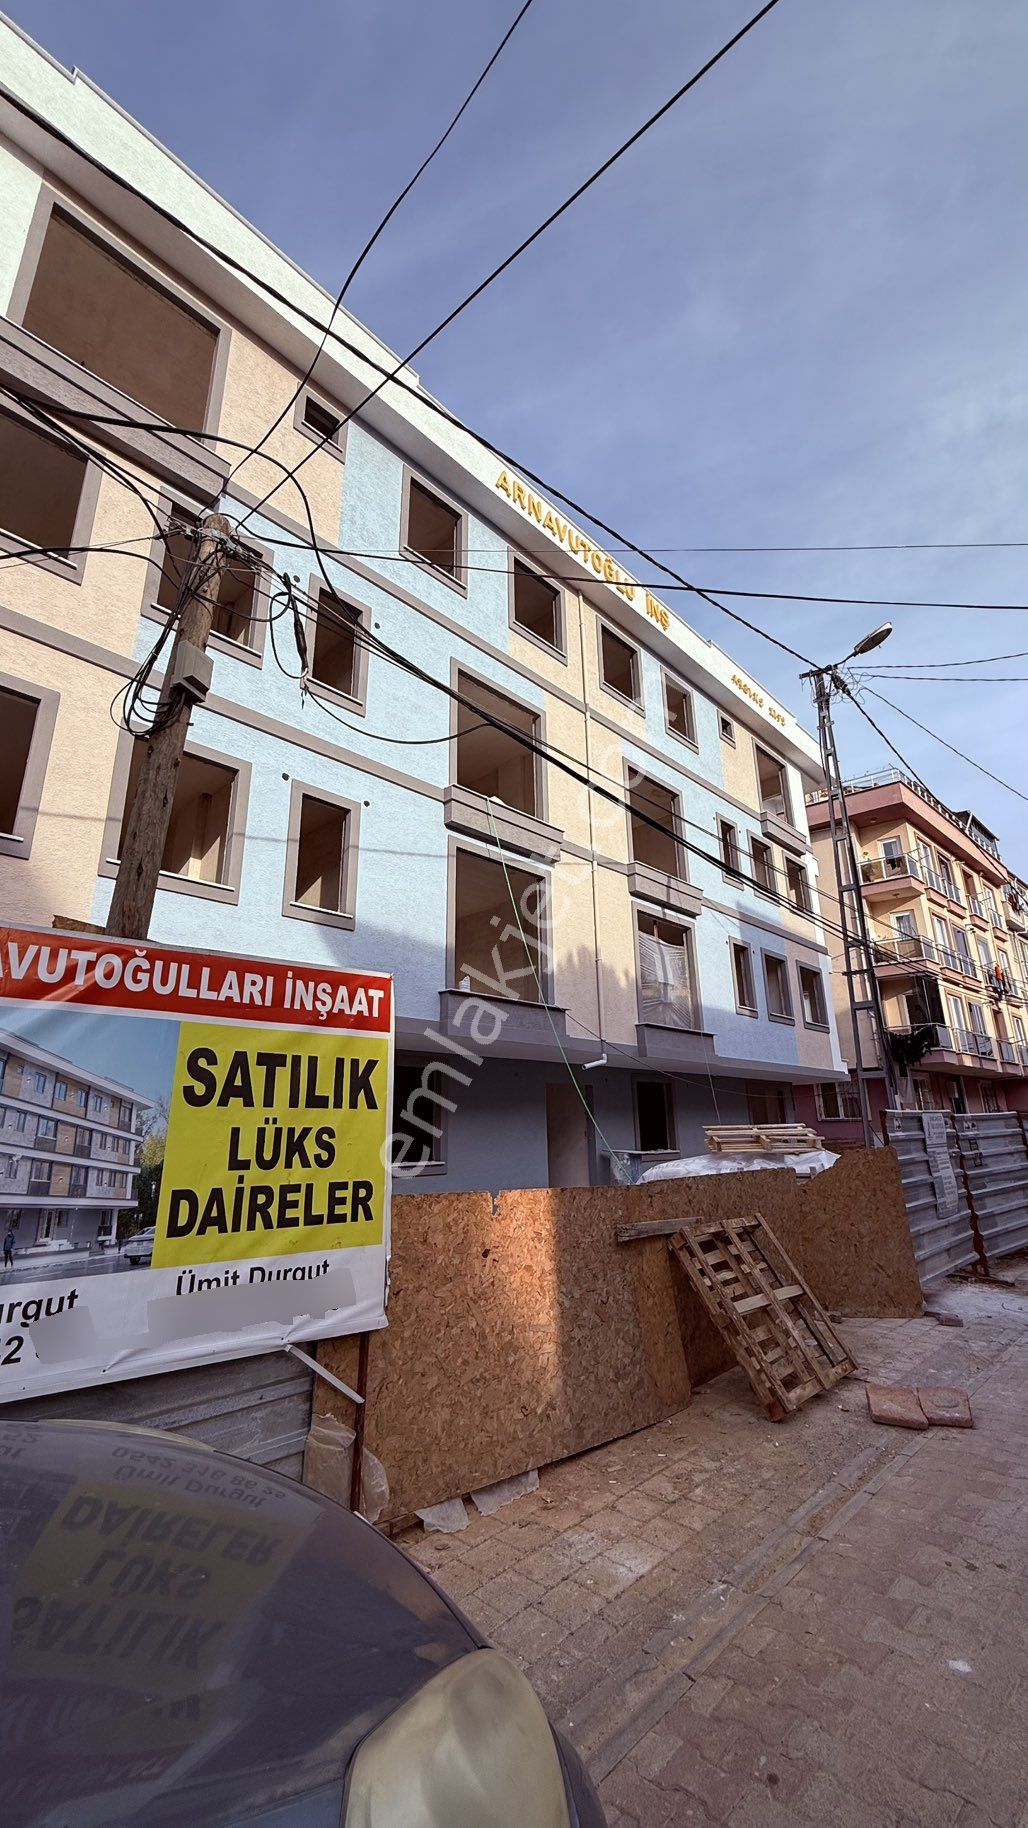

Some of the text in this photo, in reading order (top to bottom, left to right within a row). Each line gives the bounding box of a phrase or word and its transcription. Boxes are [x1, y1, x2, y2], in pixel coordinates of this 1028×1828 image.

[495, 470, 670, 631] ARNAVUTOĞLU İNŞ
[0, 942, 384, 1020] VUTOĞULLARI İNŞAAT
[182, 1047, 379, 1110] SATILIK
[228, 1117, 336, 1171] LÜKS
[166, 1175, 374, 1238] DAİRELER
[0, 1289, 79, 1328] rgut
